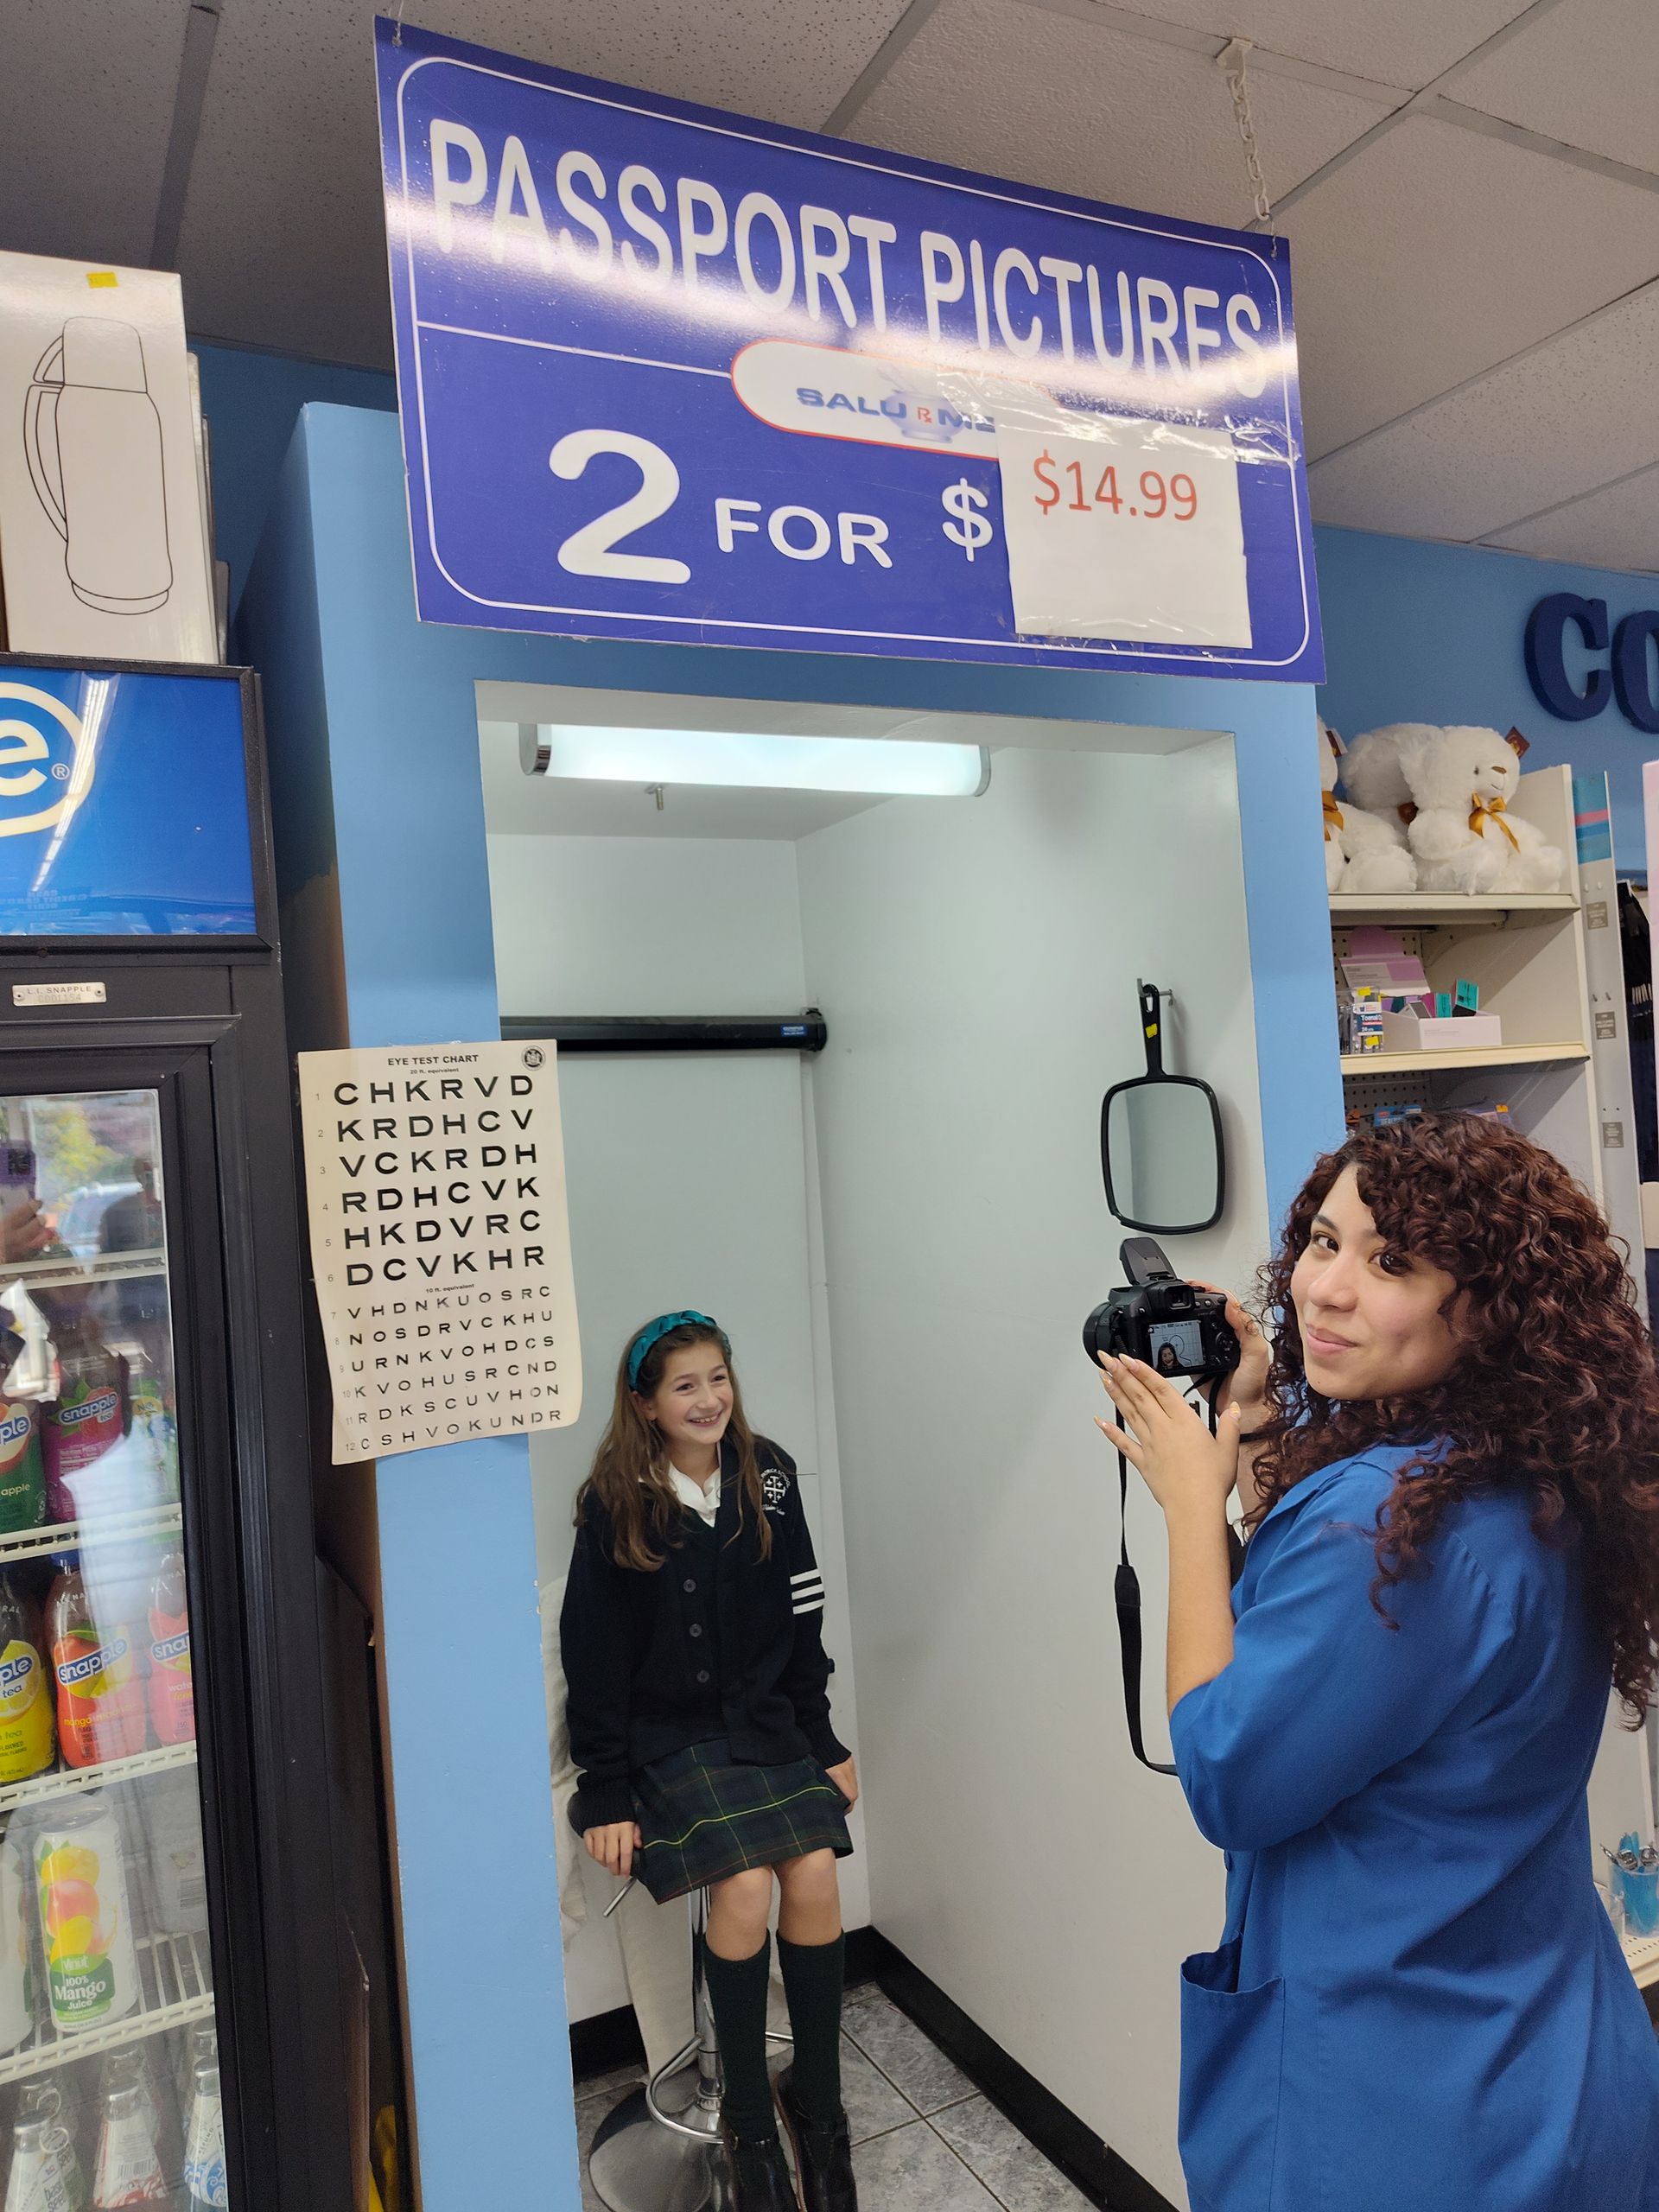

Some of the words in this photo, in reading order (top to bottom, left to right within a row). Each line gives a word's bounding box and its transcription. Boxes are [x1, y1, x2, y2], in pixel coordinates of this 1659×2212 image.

[429, 118, 897, 334] PASSPORT
[919, 230, 1267, 399] PICTURES
[1033, 449, 1198, 521] $14.99
[549, 429, 690, 584] 2
[715, 498, 893, 569] FOR
[940, 477, 993, 562] $
[47, 985, 92, 994] SNAPPLE
[412, 1056, 439, 1065] TEST
[442, 1054, 479, 1064] CHART
[327, 1274, 334, 1282] 6
[443, 1283, 474, 1292] equivalent
[63, 1392, 117, 1421] snapple
[1, 1484, 30, 1496] apple
[60, 1642, 127, 1682] snapple
[3, 1685, 22, 1699] tea
[64, 1717, 92, 1727] mango
[66, 1975, 89, 1986] 100%
[54, 1981, 106, 2000] Mango
[67, 1999, 92, 2010] Juice
